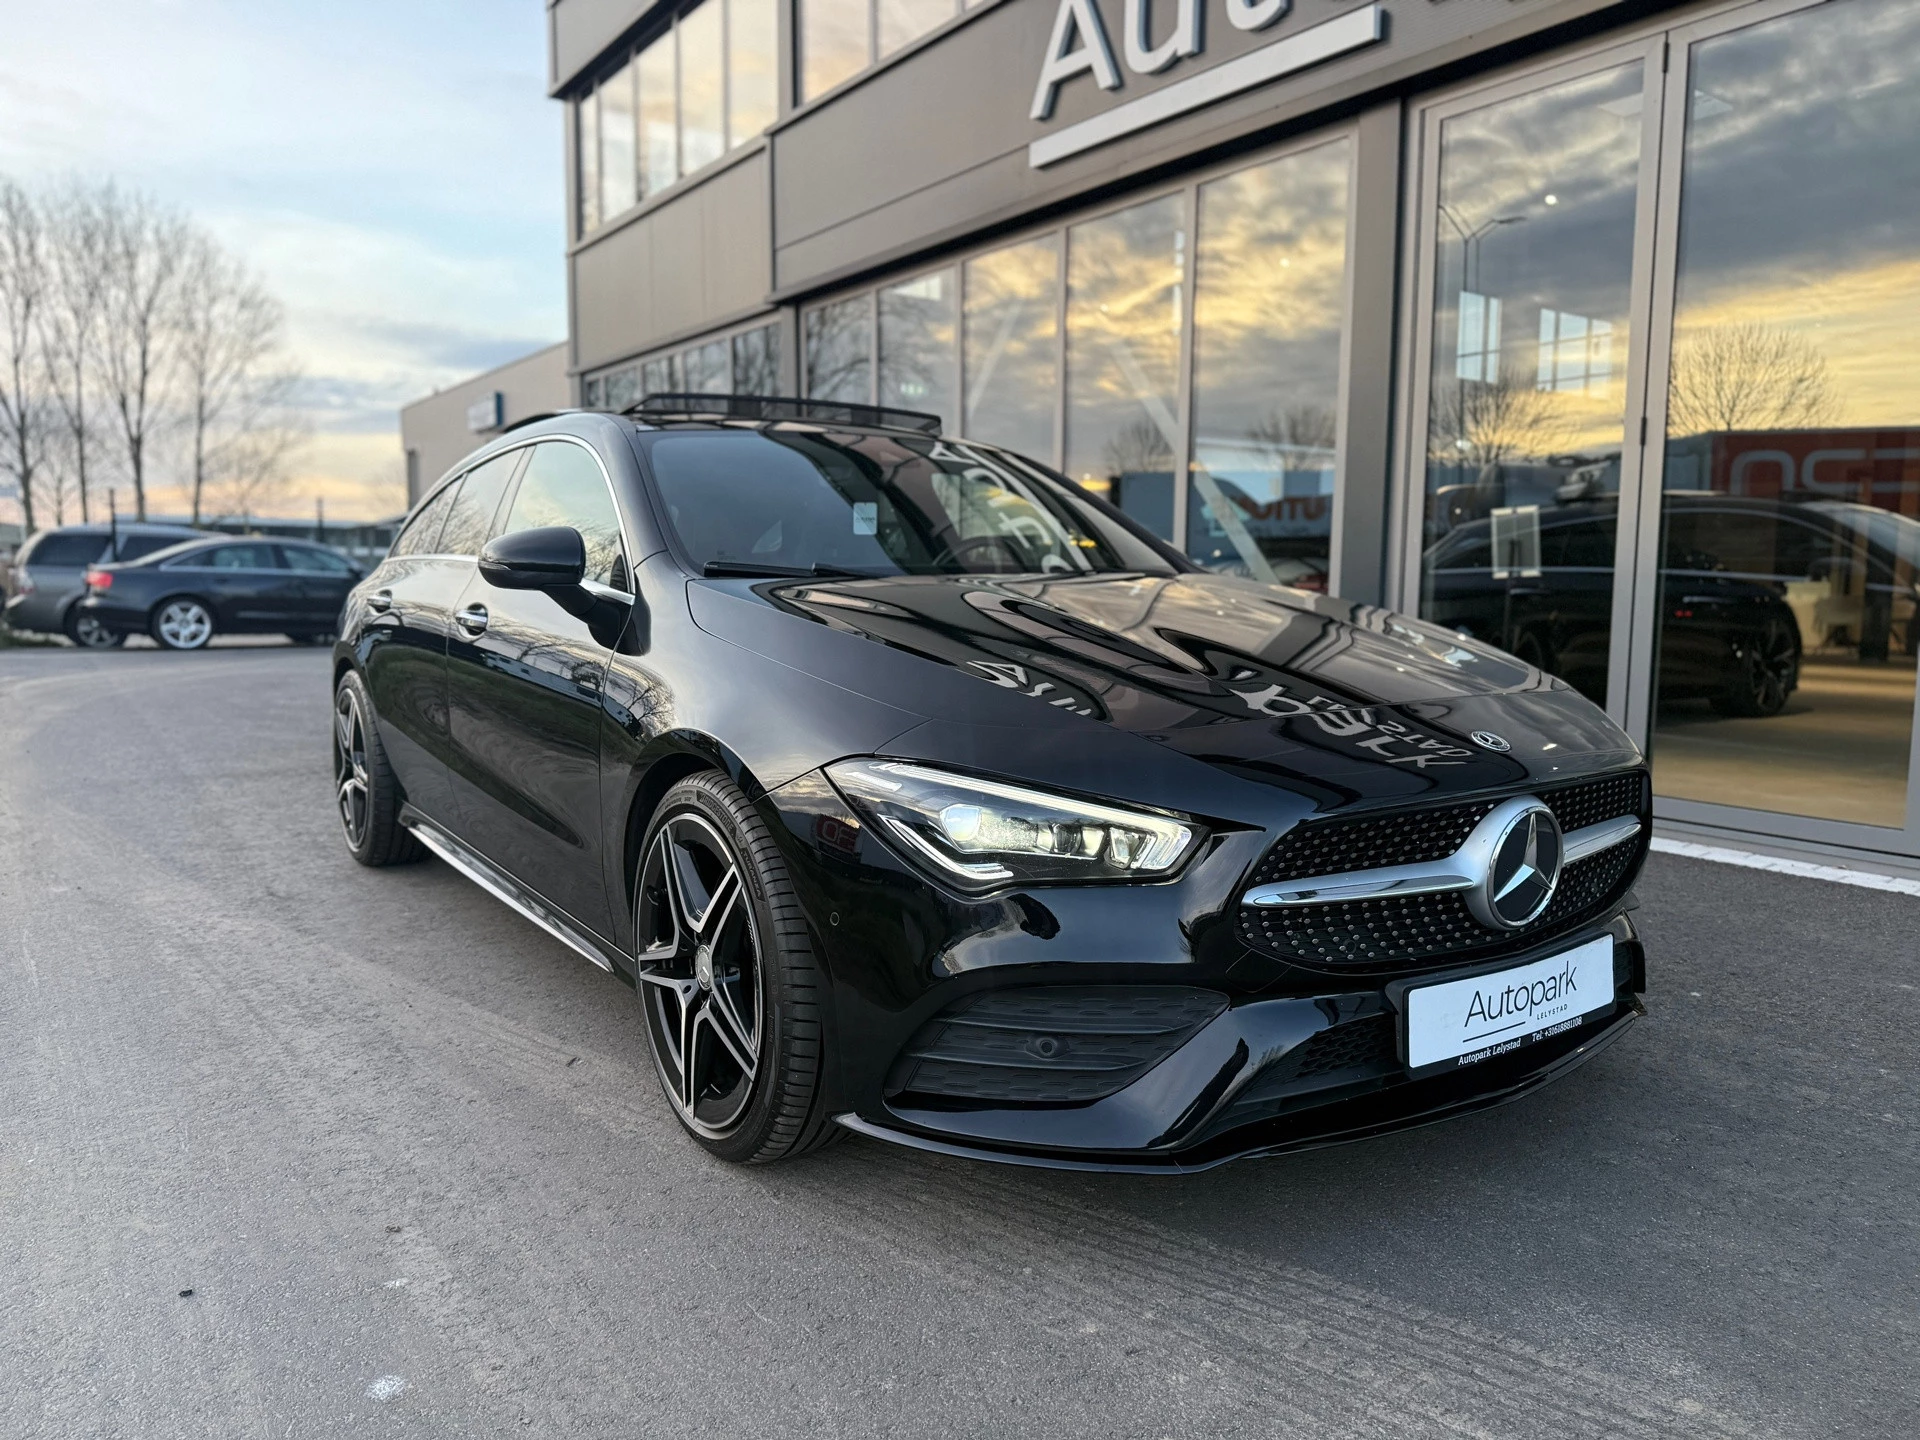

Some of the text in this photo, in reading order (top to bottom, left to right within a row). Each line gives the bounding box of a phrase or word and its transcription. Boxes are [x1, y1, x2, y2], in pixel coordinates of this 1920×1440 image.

[1463, 960, 1577, 1028] Autopark
[1536, 1003, 1568, 1020] LELYSTAD
[1458, 1047, 1491, 1066] Autopark
[1491, 1038, 1521, 1056] Lelystad
